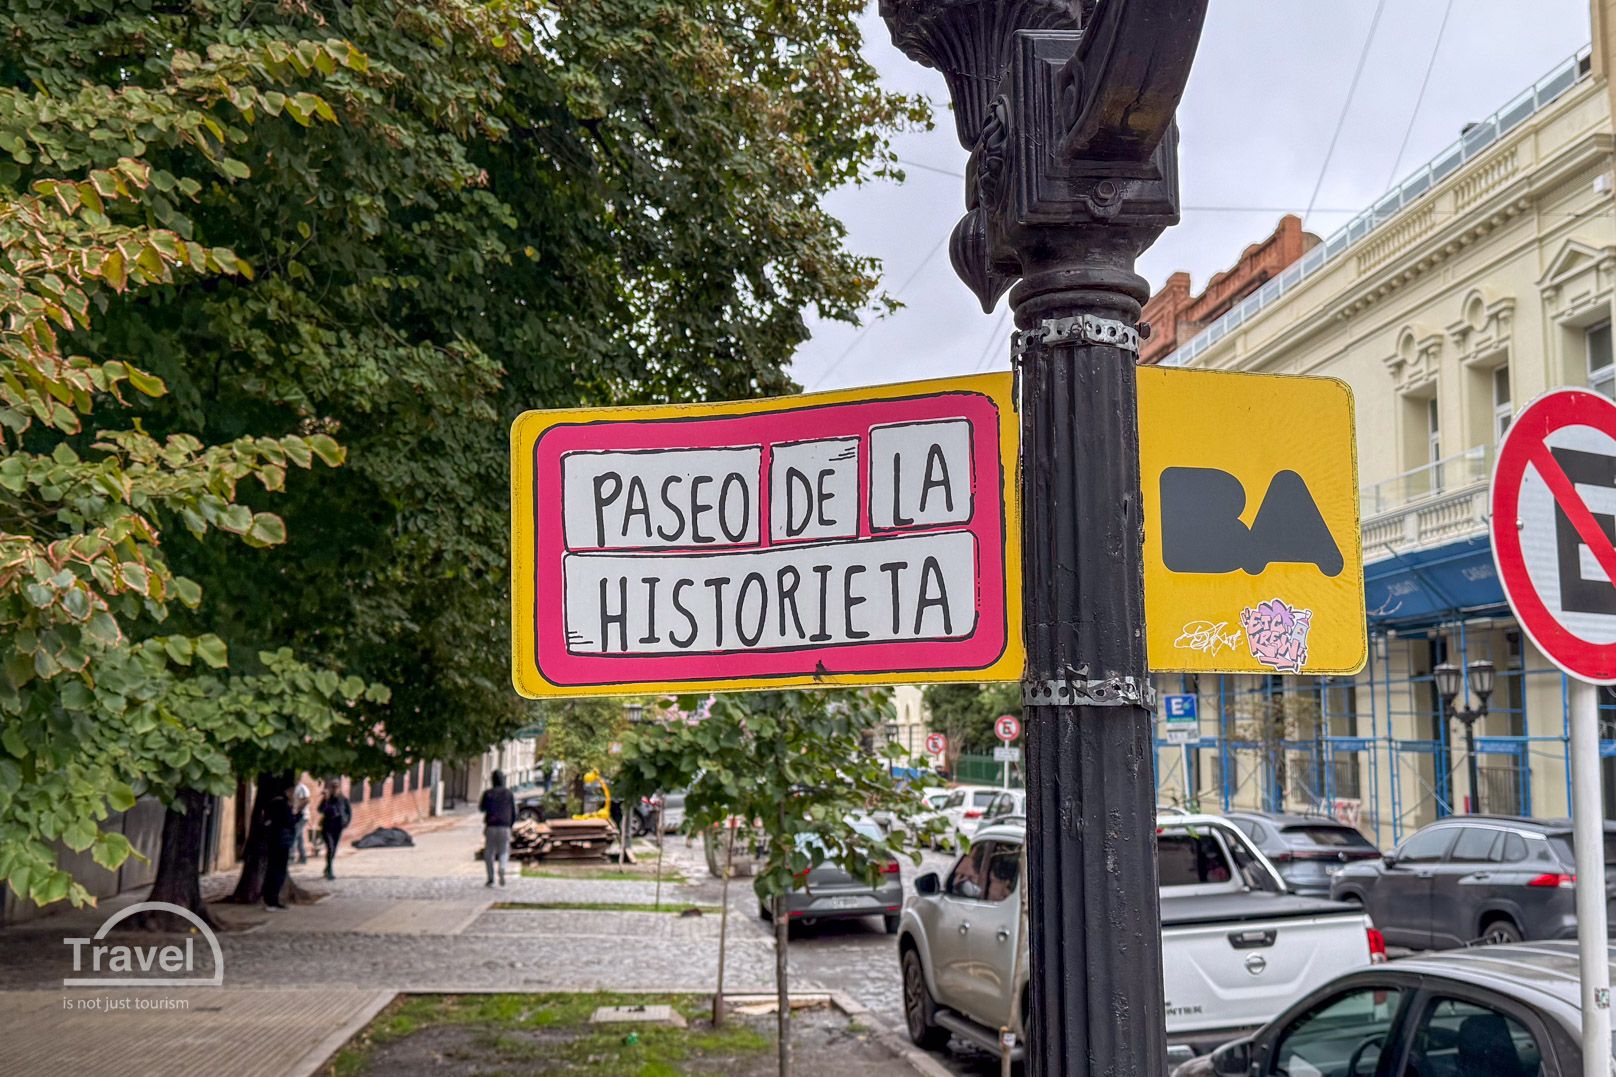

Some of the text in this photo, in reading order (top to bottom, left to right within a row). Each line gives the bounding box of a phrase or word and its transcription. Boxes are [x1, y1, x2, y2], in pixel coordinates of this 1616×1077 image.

[593, 443, 954, 547] PASEO DE LA
[1159, 466, 1344, 577] BA
[599, 556, 952, 653] HISTORIETA
[1171, 698, 1185, 715] E
